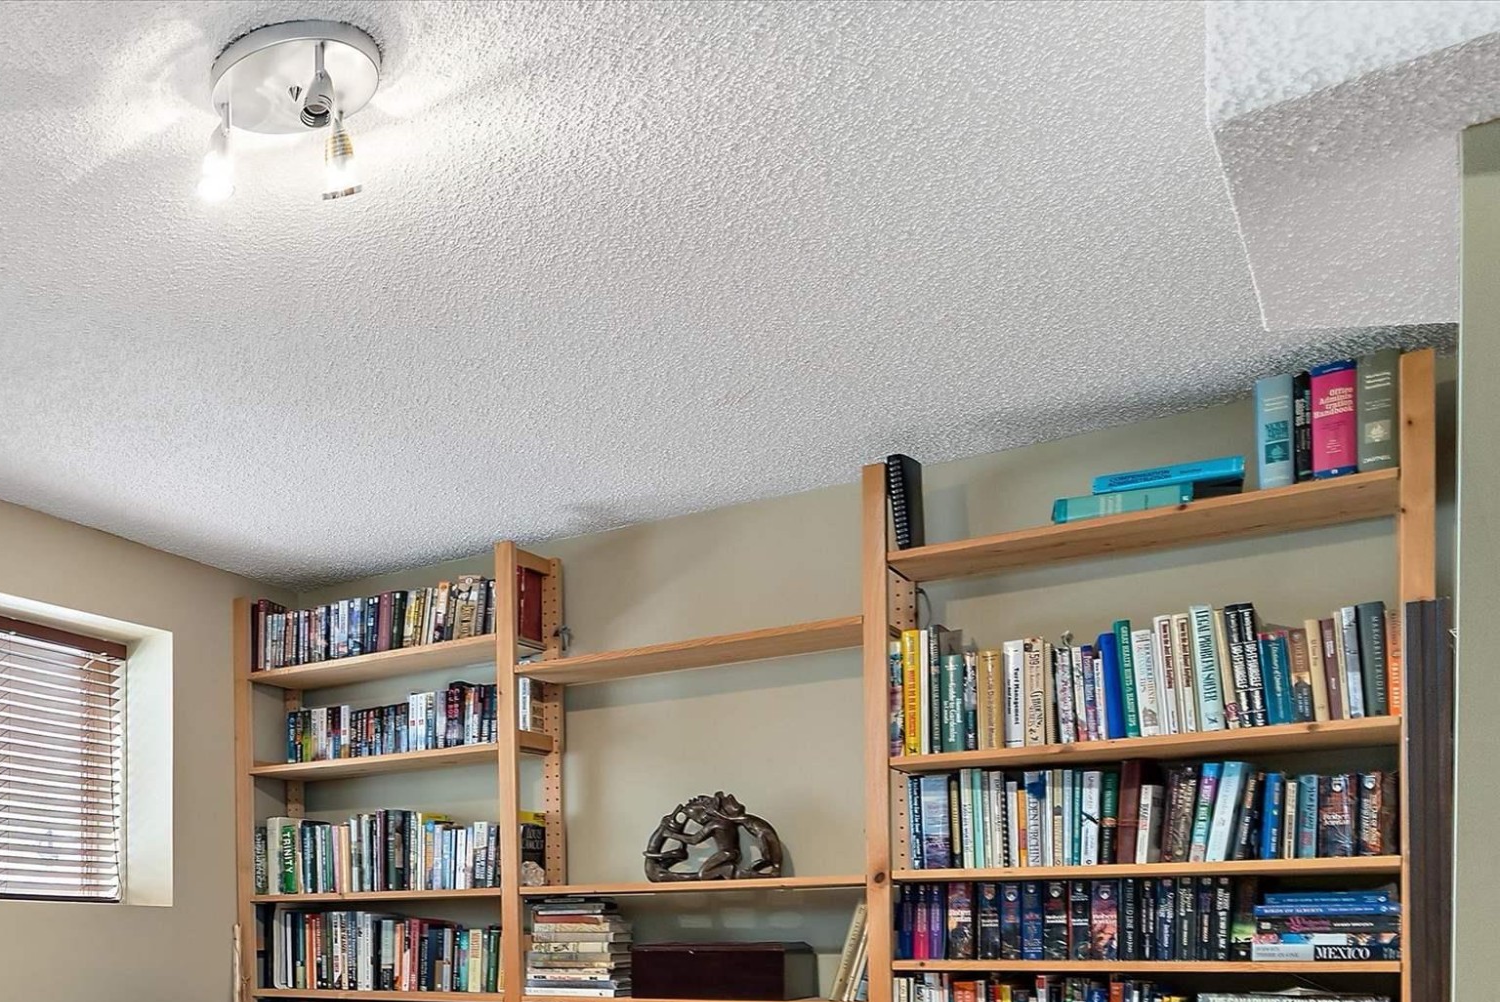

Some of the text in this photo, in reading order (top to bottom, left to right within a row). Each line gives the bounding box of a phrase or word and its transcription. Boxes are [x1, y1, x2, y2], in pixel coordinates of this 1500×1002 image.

[1120, 626, 1130, 644] GREAT
[1122, 645, 1132, 668] HEALTH
[1195, 610, 1218, 703] LEGAL PROBLEM SOLVER
[1232, 644, 1248, 689] DO-IT-YOURSELF
[1246, 643, 1262, 688] DO-IT-YOURSELF
[1371, 616, 1385, 704] MARGARET TRUDEAU
[1124, 668, 1133, 686] HINTS
[1144, 643, 1156, 704] HOUSEHOLD HINTS
[1165, 670, 1174, 690] Anything
[1182, 668, 1191, 688] Anything
[1012, 684, 1020, 725] Management
[1126, 693, 1135, 713] HANDY
[948, 709, 958, 742] Gardening
[1128, 714, 1137, 727] TIPS
[282, 832, 294, 874] TRINITY
[1028, 823, 1040, 863] URCHIN
[1315, 945, 1371, 960] MEXICO
